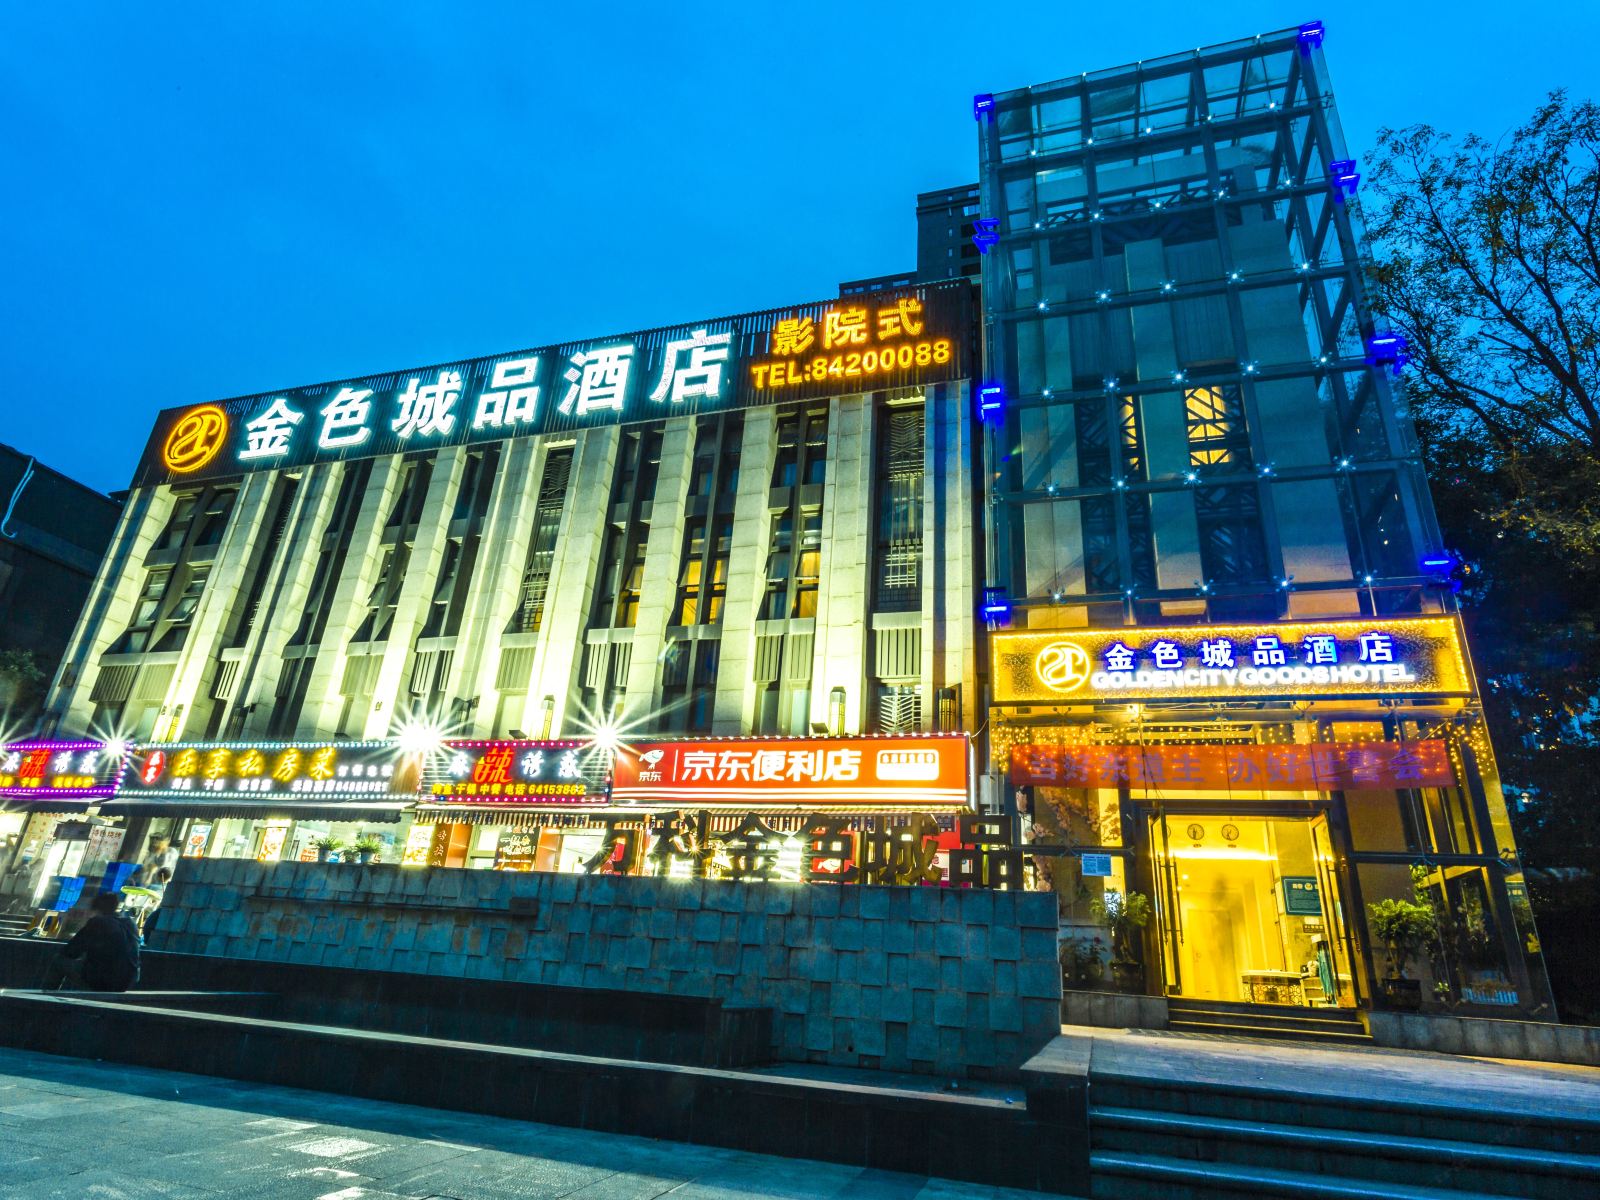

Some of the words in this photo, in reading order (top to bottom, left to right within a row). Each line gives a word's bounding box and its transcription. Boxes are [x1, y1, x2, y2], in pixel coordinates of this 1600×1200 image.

[773, 298, 923, 356] 影院式
[751, 341, 951, 390] TEL:84200088
[237, 329, 734, 460] 金色城品酒店
[1105, 633, 1394, 671] 金色城品酒店
[173, 747, 337, 782] 乐享私房菜
[638, 771, 662, 782] 京东
[681, 749, 862, 782] 京东便利店
[1030, 749, 1206, 784] 当好东道主
